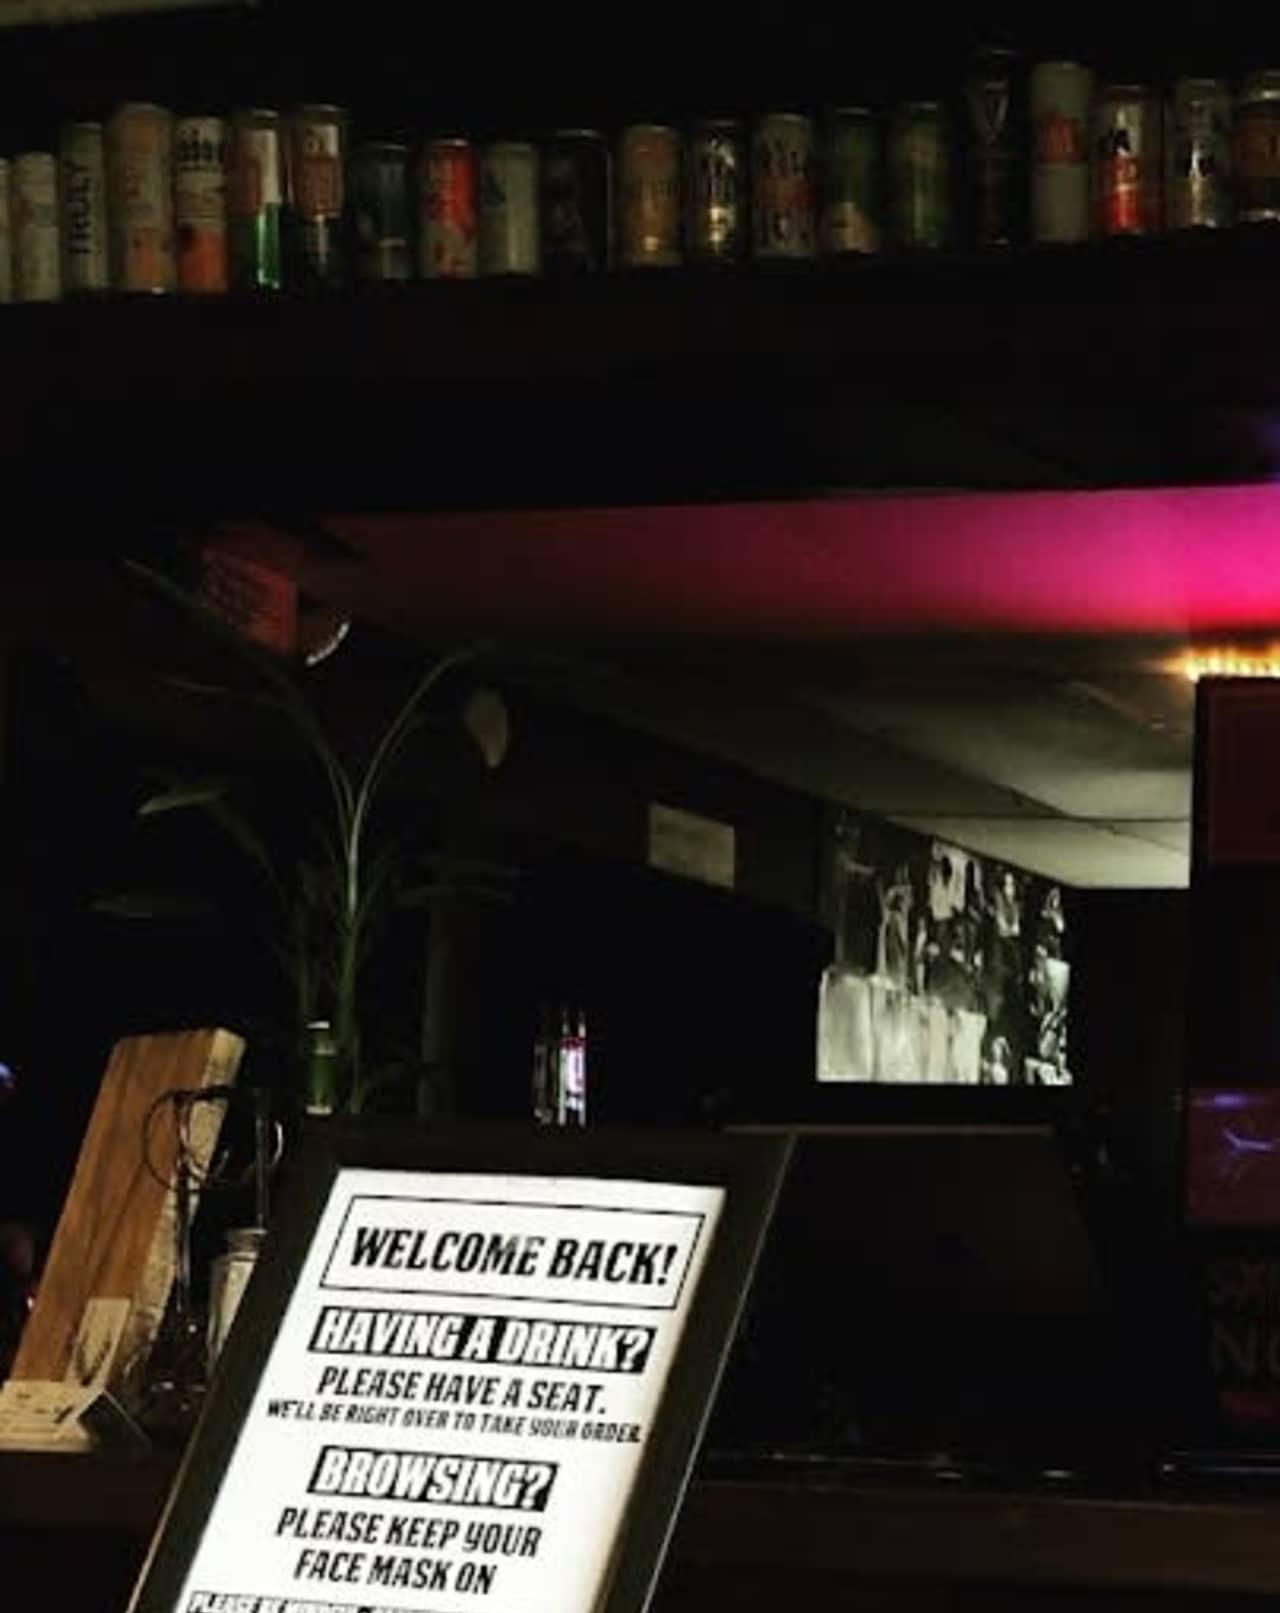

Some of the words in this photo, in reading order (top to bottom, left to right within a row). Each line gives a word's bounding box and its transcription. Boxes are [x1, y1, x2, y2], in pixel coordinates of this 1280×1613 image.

[350, 1226, 546, 1277] WELCOME
[547, 1238, 678, 1286] BACK!
[315, 1308, 465, 1360] HAVING
[461, 1316, 496, 1362] A
[498, 1320, 650, 1372] DRINK?
[316, 1366, 424, 1401] PLEASE
[428, 1374, 501, 1407] HAVE
[502, 1379, 526, 1409] A
[526, 1380, 607, 1414] SEAT.
[266, 1400, 318, 1420] WE'LL
[319, 1402, 342, 1422] BE
[345, 1404, 399, 1426] RIGHT
[402, 1408, 449, 1430] OVER
[452, 1412, 477, 1432] TO
[479, 1413, 525, 1435] TAKE
[528, 1416, 579, 1439] YOUR
[314, 1448, 550, 1509] BROWSING?
[276, 1507, 382, 1545] PLEASE
[385, 1515, 461, 1551] KEEP
[463, 1521, 542, 1557] YOUR
[294, 1548, 363, 1585] FACE
[366, 1554, 452, 1592] MASK
[455, 1561, 497, 1597] ON
